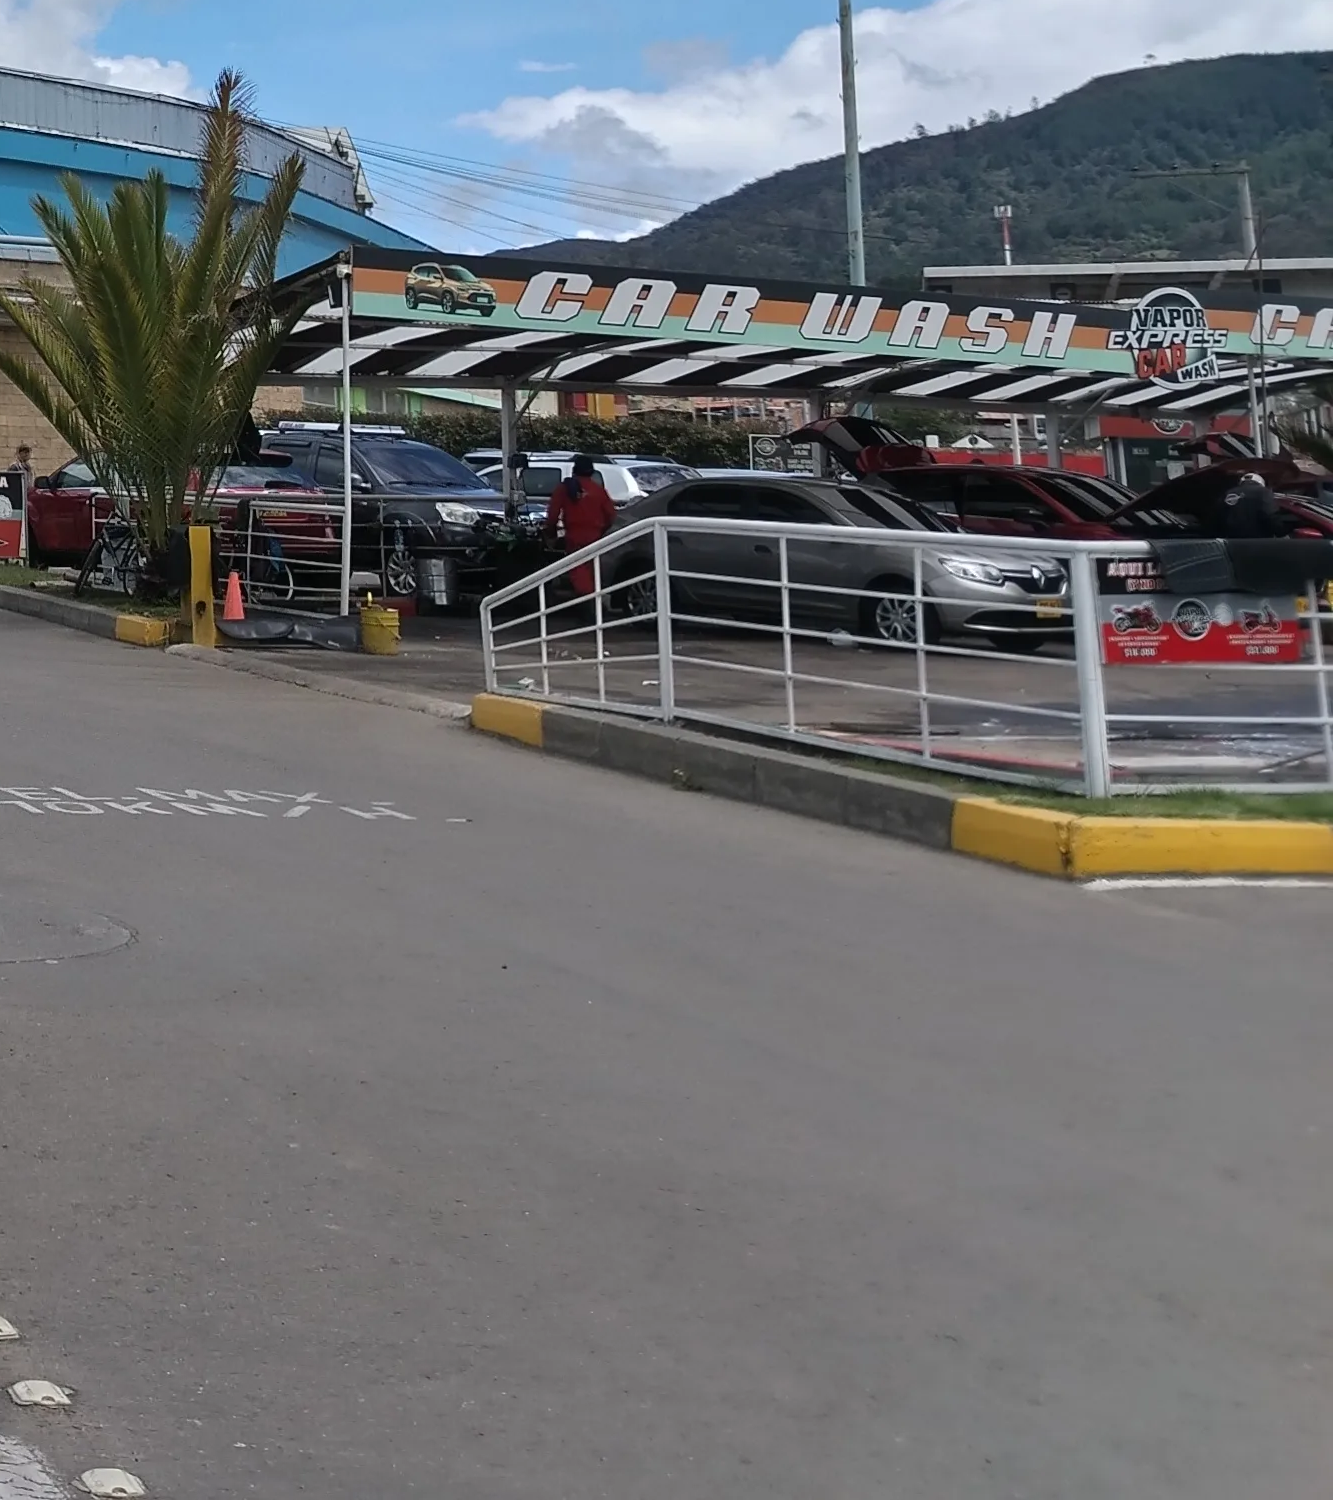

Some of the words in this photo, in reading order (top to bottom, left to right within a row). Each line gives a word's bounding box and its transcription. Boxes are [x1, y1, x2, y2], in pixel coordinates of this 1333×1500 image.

[513, 271, 762, 335] CAR
[799, 292, 1077, 360] WASH
[1132, 307, 1207, 329] VAPOR
[1107, 329, 1228, 349] EXPRESS
[1137, 344, 1186, 380] CAR
[1181, 359, 1217, 381] WASH
